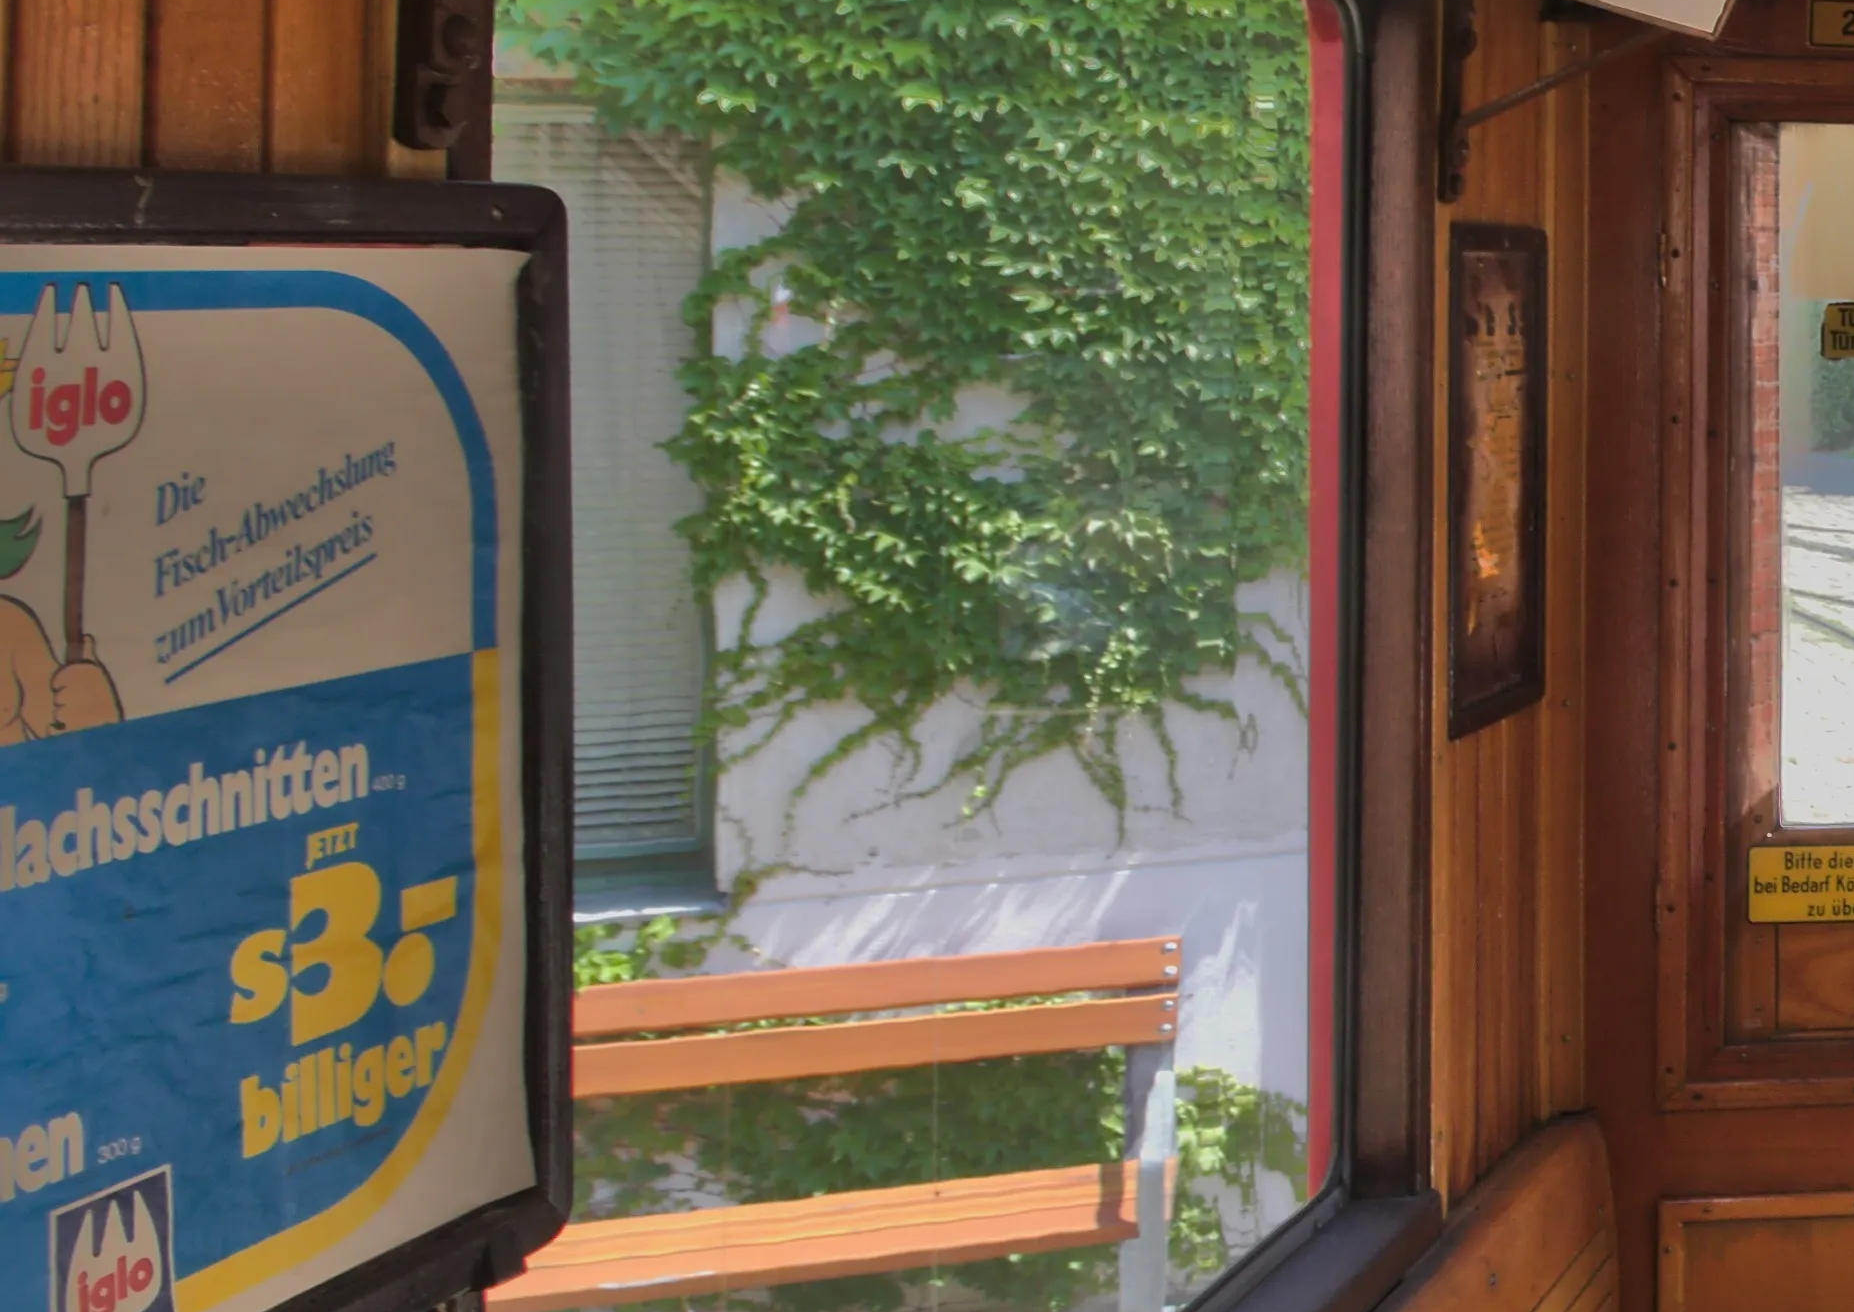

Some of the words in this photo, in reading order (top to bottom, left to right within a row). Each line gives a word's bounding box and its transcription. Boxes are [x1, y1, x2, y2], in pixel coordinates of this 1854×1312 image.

[28, 366, 132, 447] iglo
[154, 441, 397, 599] Fisch-Abwechslung
[155, 471, 206, 527] Die
[155, 607, 216, 664] zum
[215, 510, 373, 627] Vorteilspreis
[305, 821, 359, 870] JETZT
[1784, 851, 1823, 870] Bitte
[1753, 878, 1778, 894] bei
[1781, 876, 1831, 894] Bedarf
[1807, 903, 1826, 917] zu
[240, 1020, 447, 1159] billiger
